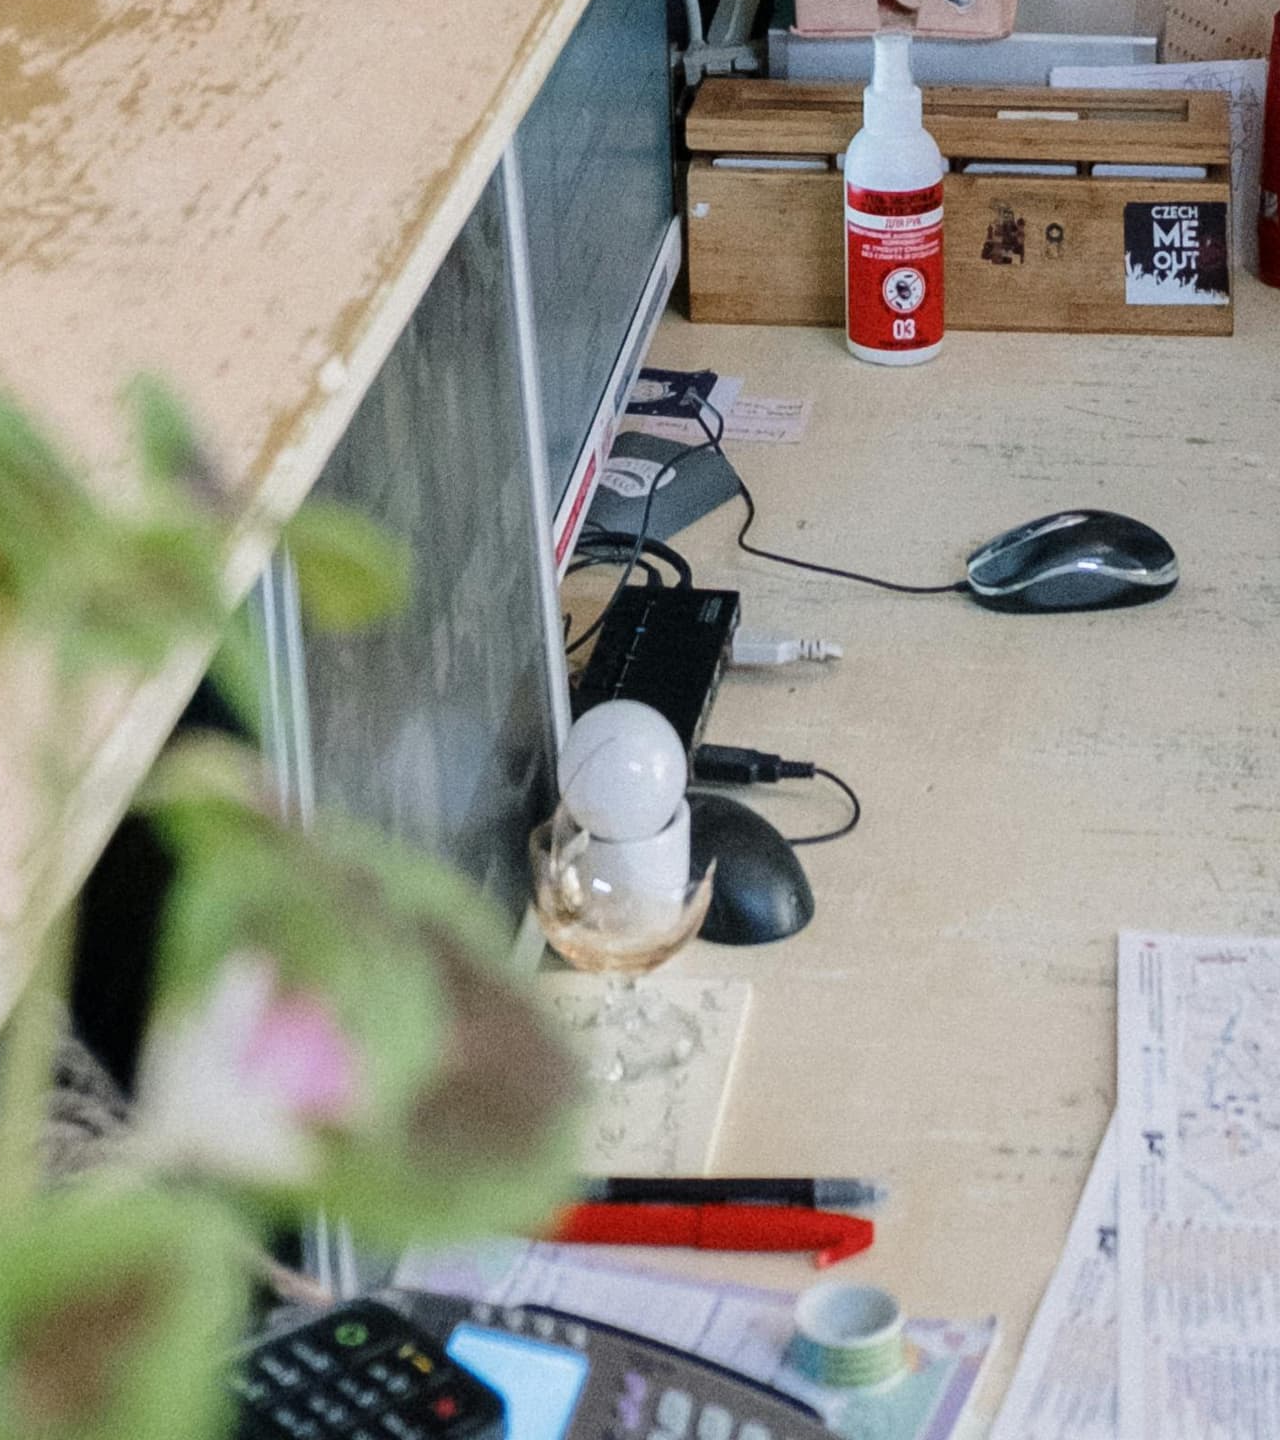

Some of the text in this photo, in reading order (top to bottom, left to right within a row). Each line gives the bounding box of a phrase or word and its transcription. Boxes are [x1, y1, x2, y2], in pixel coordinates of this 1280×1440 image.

[1151, 205, 1199, 220] CZECH
[1152, 220, 1200, 249] ME
[1152, 250, 1200, 271] OUT
[892, 318, 917, 341] 03
